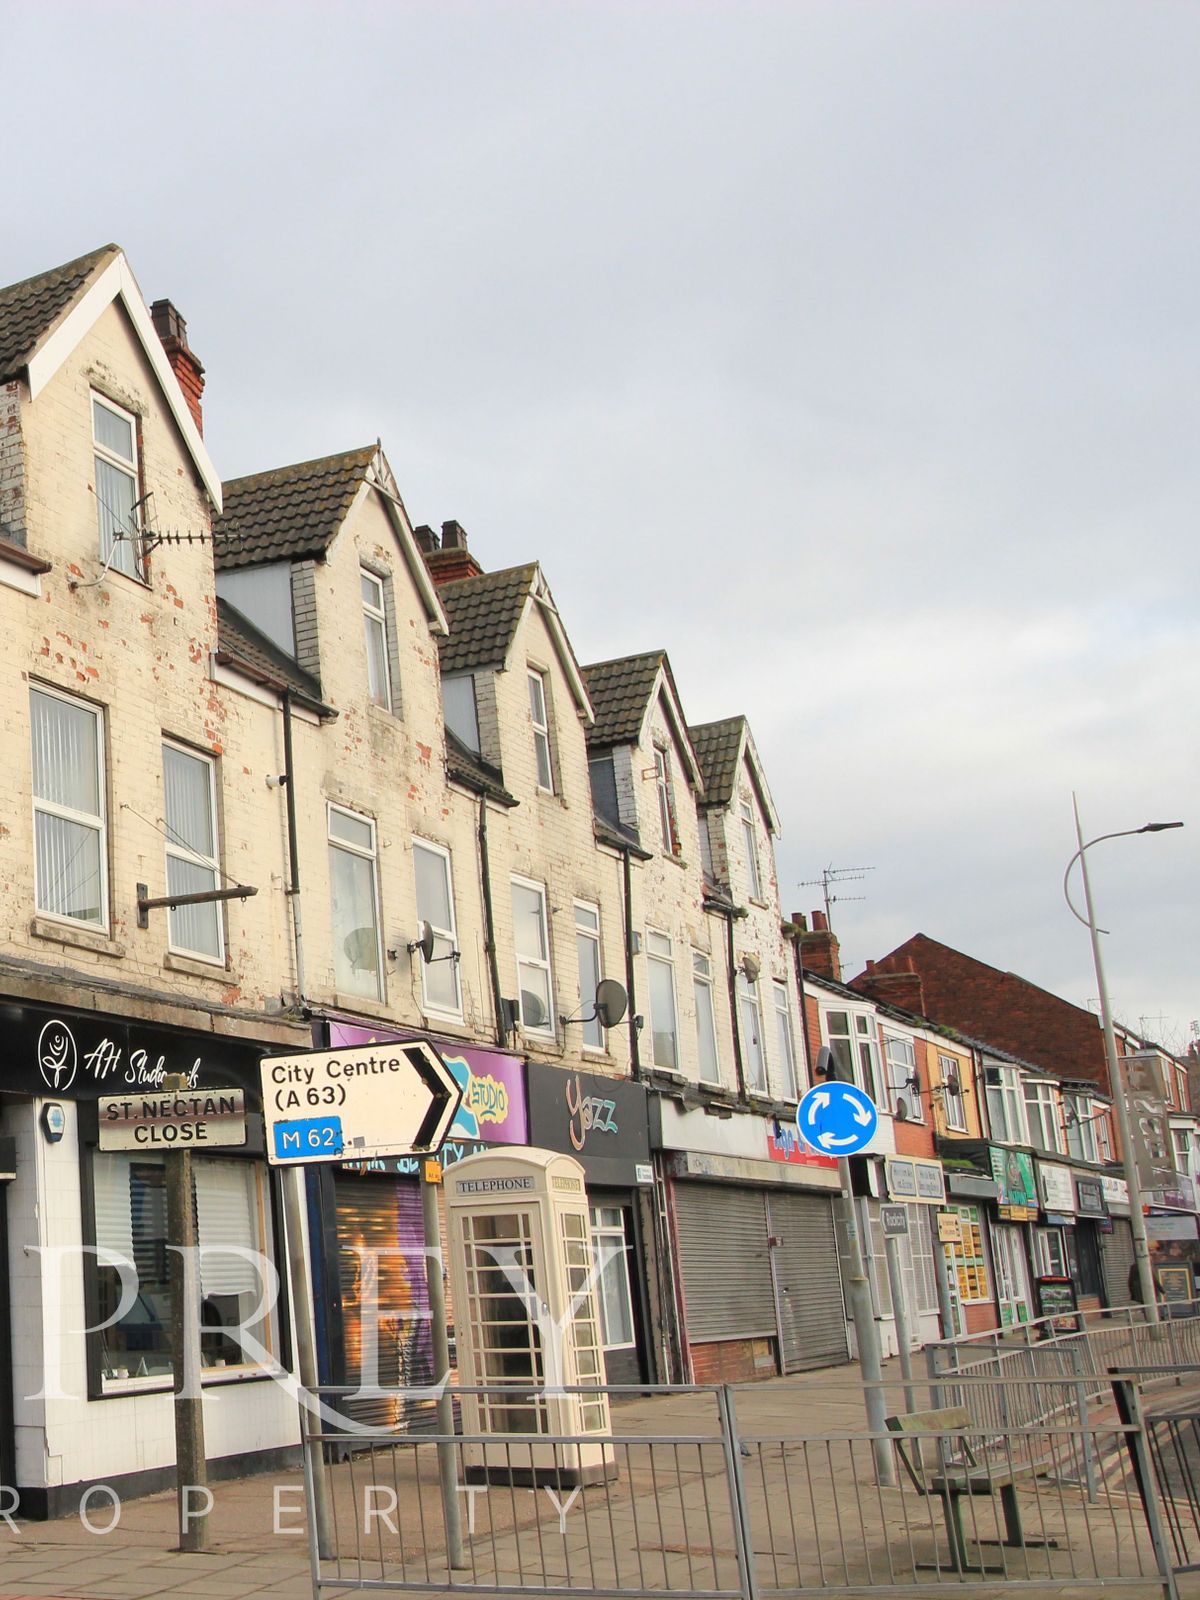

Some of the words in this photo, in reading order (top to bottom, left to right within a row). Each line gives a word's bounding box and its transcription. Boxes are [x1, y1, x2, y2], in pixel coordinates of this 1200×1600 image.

[84, 1038, 121, 1079] AH
[271, 1065, 314, 1085] City
[326, 1056, 400, 1077] Centre
[471, 1081, 505, 1112] STUDIO
[565, 1074, 619, 1151] Yazz
[134, 1122, 208, 1142] CLOSE
[460, 1178, 530, 1193] TELEPHONE
